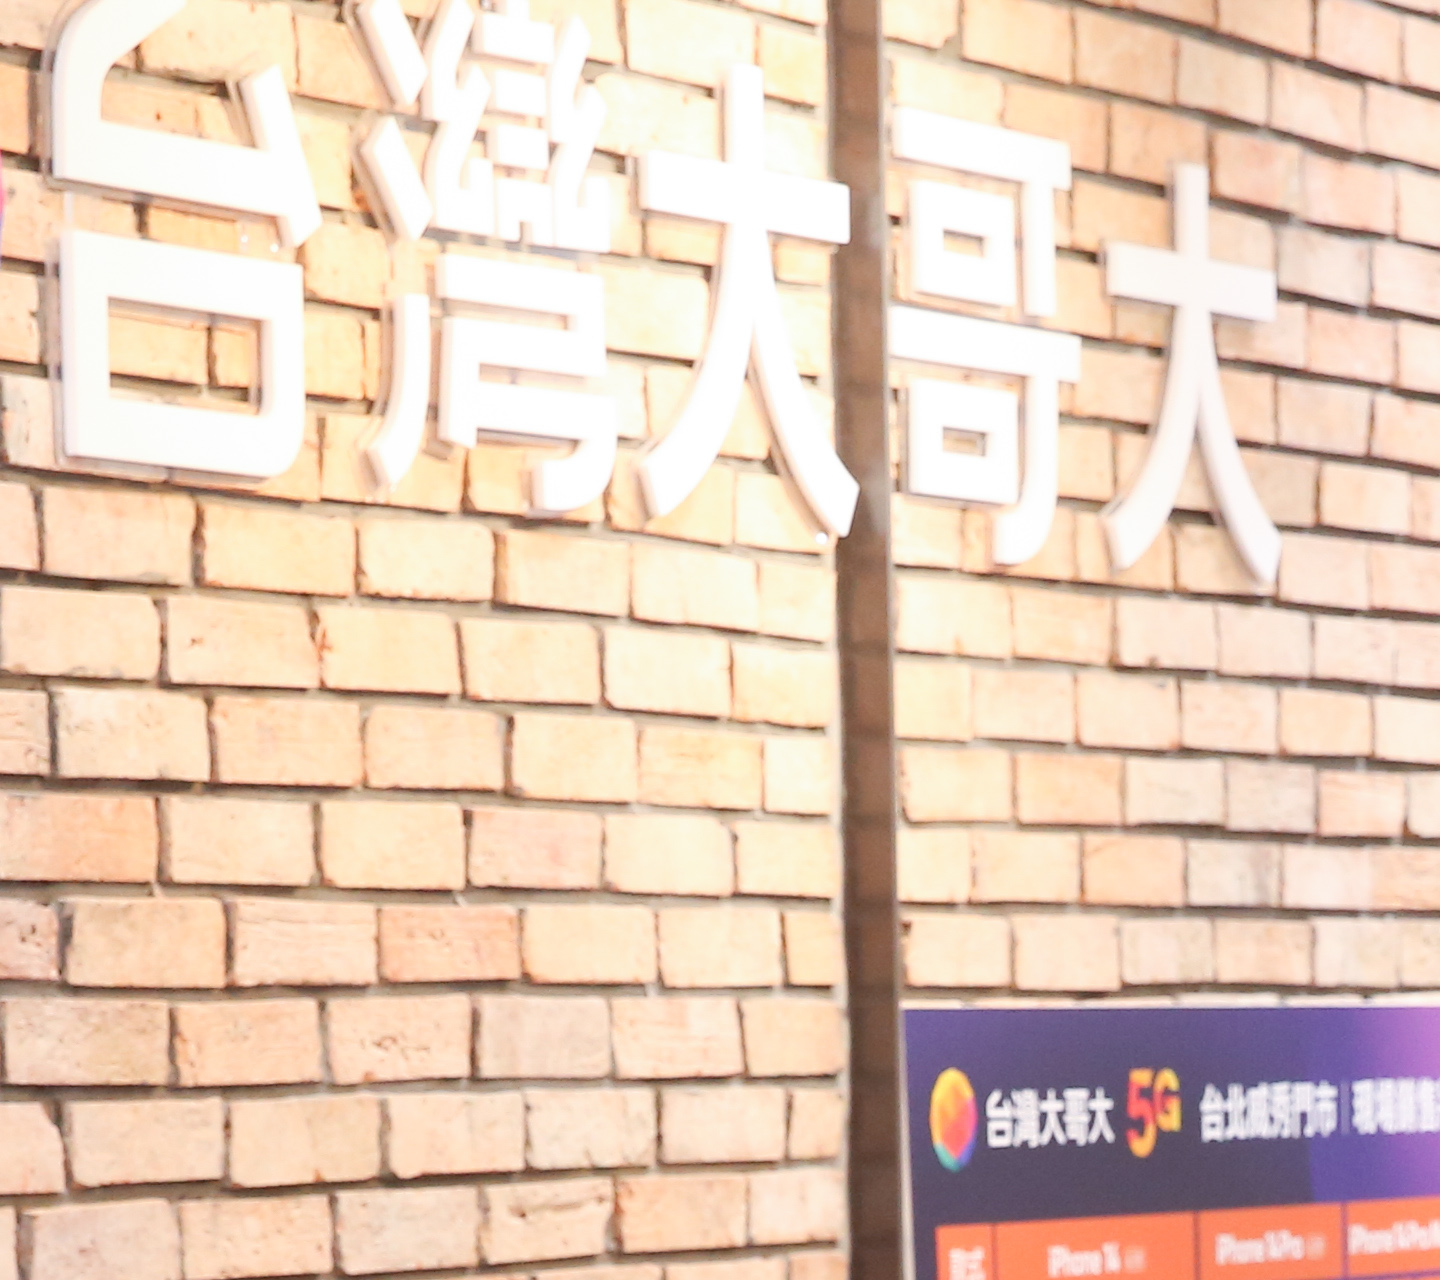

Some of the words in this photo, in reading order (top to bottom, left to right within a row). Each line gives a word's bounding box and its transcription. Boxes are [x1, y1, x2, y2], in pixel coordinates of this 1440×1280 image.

[44, 0, 1284, 592] 台灣大哥大
[985, 1087, 1115, 1148] 台灣大哥大
[1126, 1067, 1182, 1158] 5G
